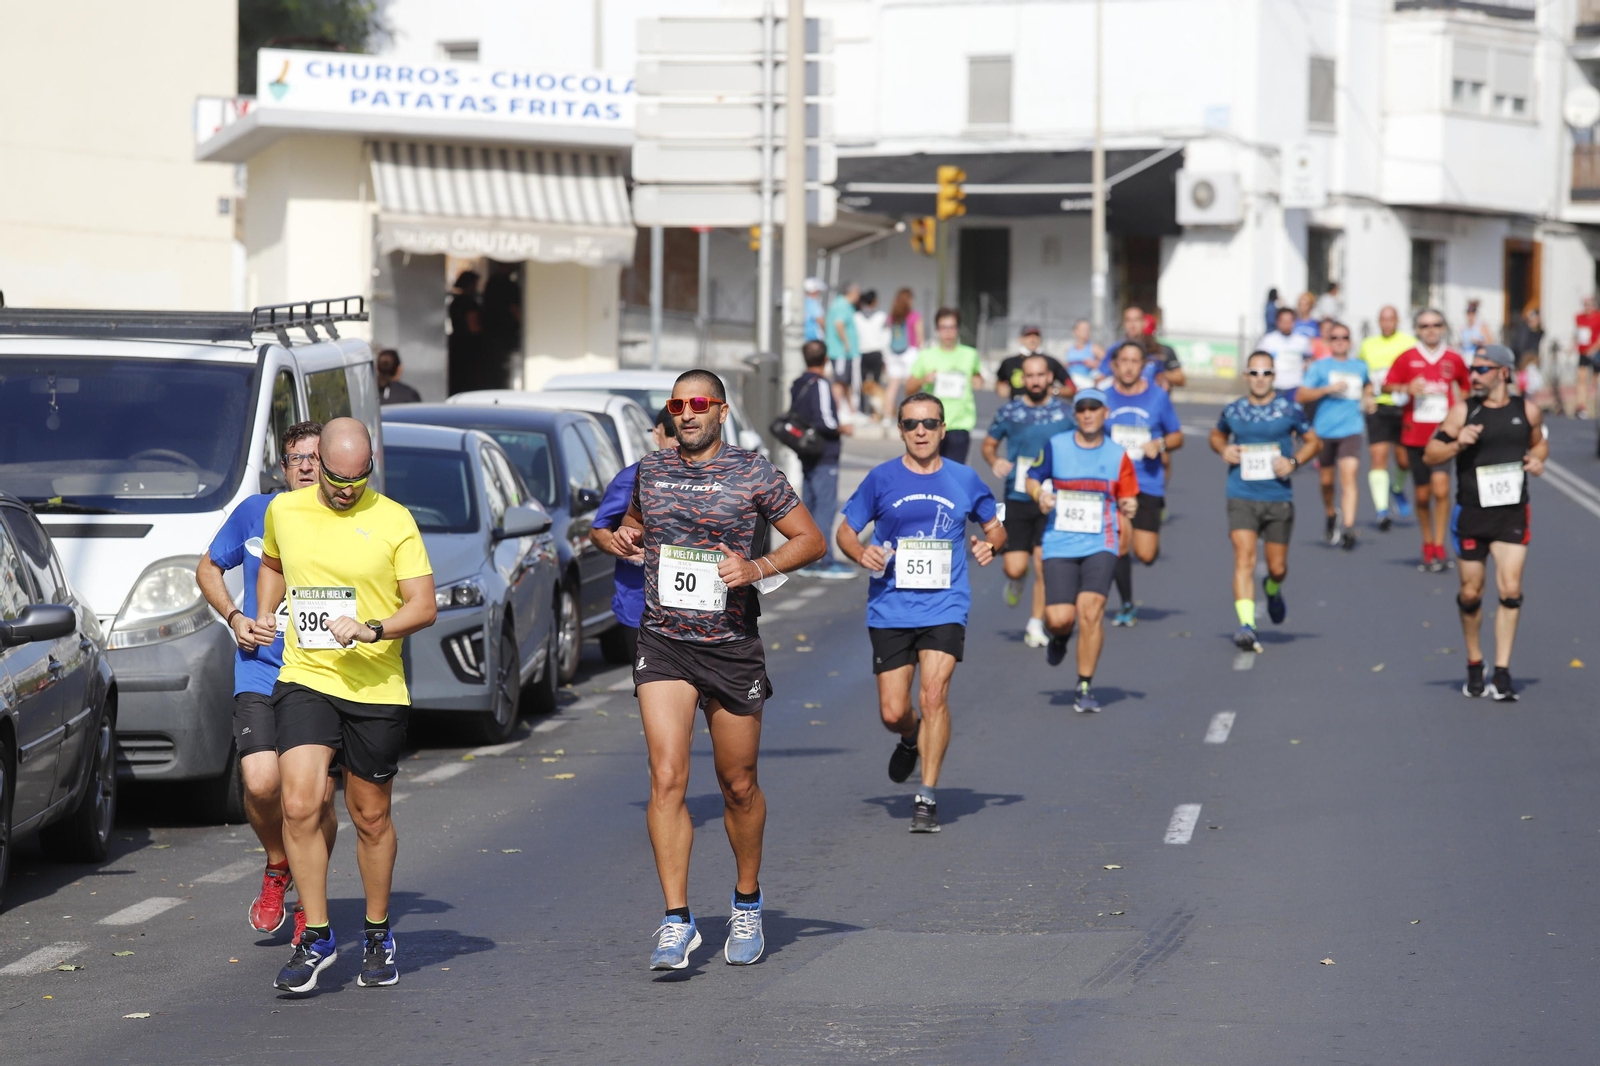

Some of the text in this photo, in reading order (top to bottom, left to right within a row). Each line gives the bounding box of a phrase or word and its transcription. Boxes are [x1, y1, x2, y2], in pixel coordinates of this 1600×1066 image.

[306, 60, 460, 86] CHURROS
[351, 88, 621, 120] PATATAS FRITAS
[654, 481, 679, 490] GET
[1489, 481, 1511, 495] 105
[1064, 508, 1085, 521] 482
[673, 549, 694, 560] VUELTA
[695, 552, 700, 561] A
[907, 559, 932, 575] 551
[674, 571, 697, 593] 50
[299, 589, 319, 598] VUELTA
[320, 590, 326, 598] A
[327, 589, 352, 599] HUELV
[299, 611, 330, 632] 396
